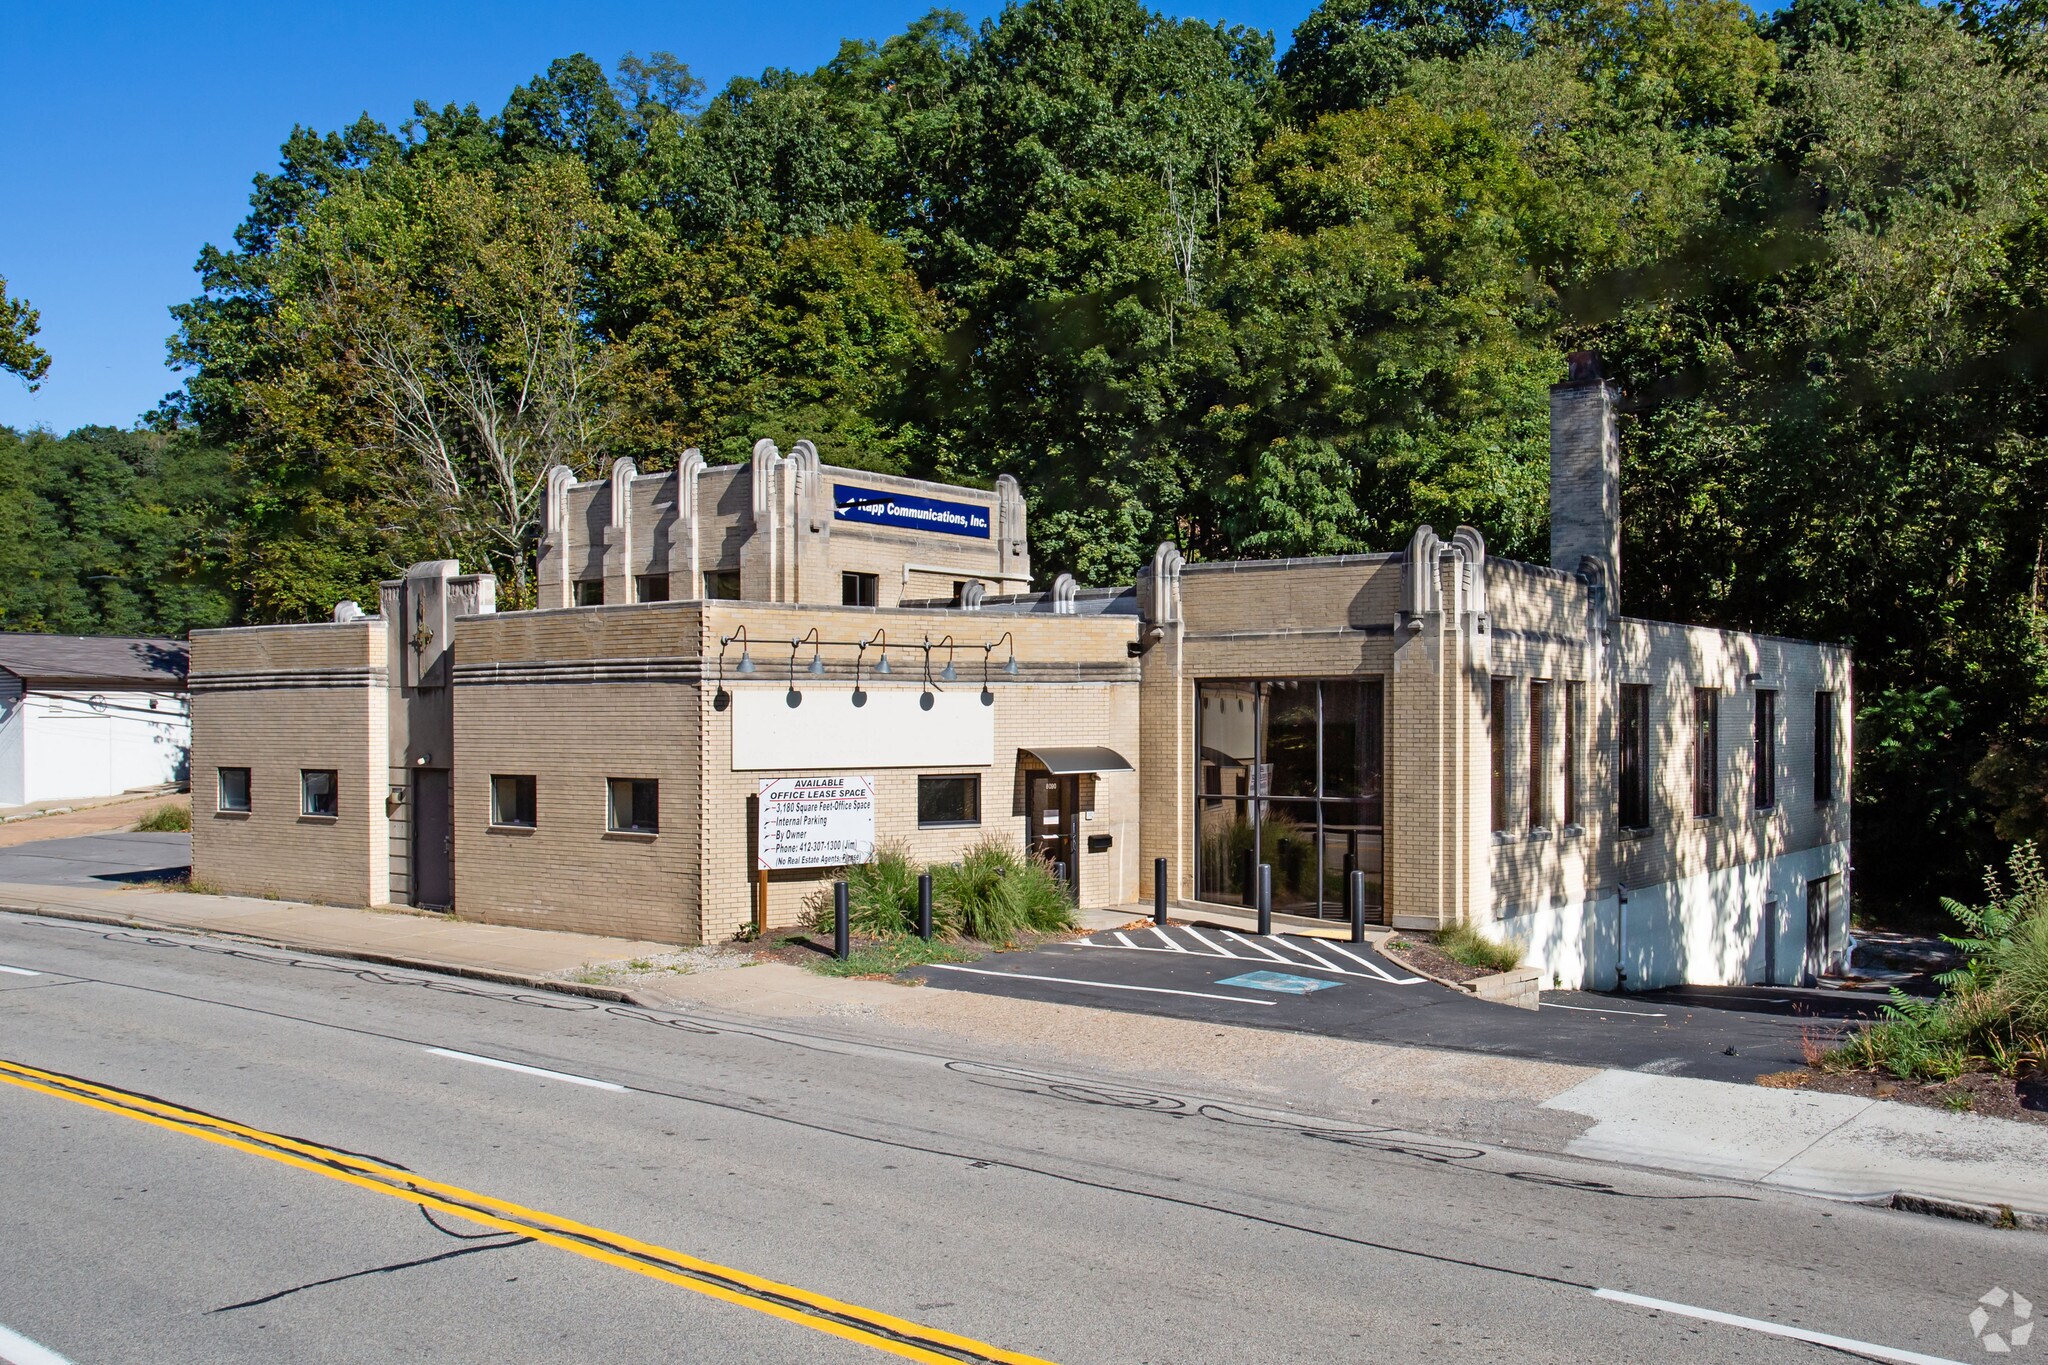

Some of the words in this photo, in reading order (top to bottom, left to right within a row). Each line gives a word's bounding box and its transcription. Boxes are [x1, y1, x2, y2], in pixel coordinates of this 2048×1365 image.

[887, 502, 968, 528] Communications,
[970, 515, 987, 528] Inc.
[795, 779, 844, 787] AVAILABLE
[770, 791, 805, 799] OFFICE
[808, 790, 837, 798] LEASE
[839, 789, 865, 797] SPACE
[776, 802, 794, 814] 3,180
[796, 802, 818, 814] Square
[819, 801, 852, 811] Feet-Office
[853, 800, 870, 811] Space
[776, 817, 802, 826] Internal
[804, 815, 827, 827] Parking
[776, 830, 784, 842] By
[786, 830, 807, 839] Owner
[776, 844, 797, 853] Phone:
[800, 840, 841, 852] 412-307-1300
[776, 857, 786, 867] (No
[787, 857, 800, 865] Real
[802, 856, 819, 864] Estate
